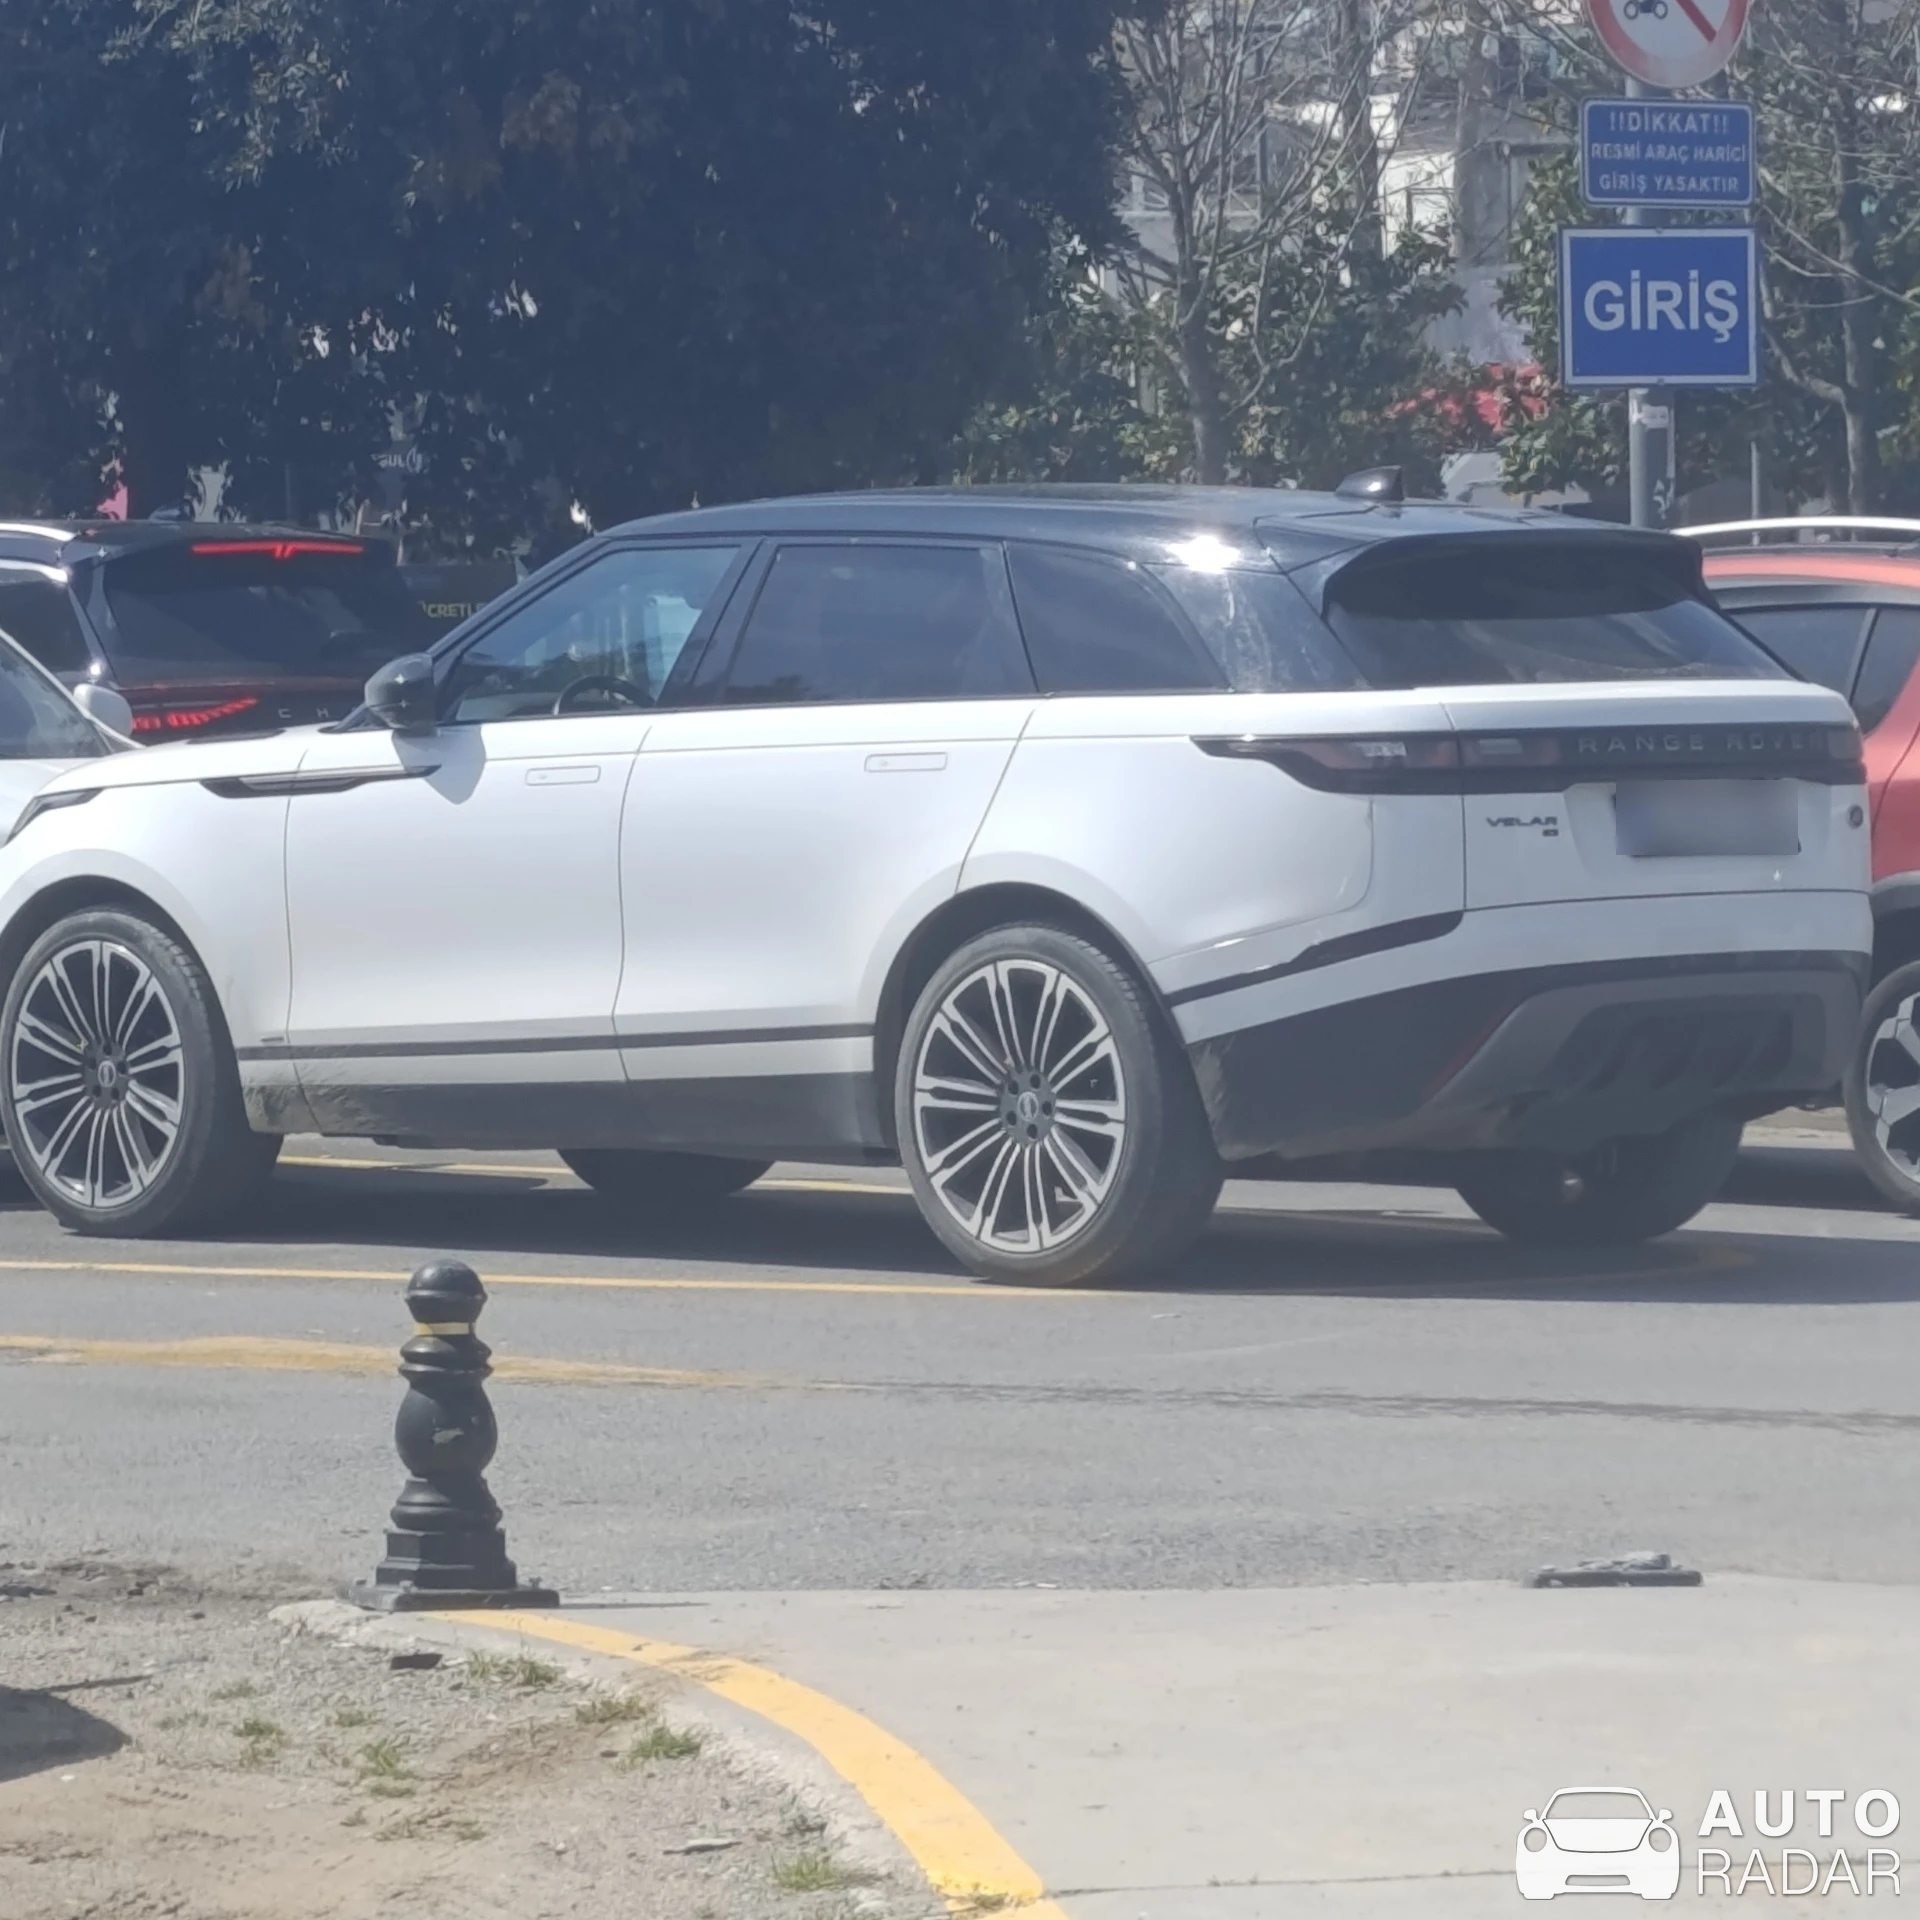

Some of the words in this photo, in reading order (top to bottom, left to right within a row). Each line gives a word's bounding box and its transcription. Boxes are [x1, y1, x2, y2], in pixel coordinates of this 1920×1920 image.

[1610, 108, 1728, 134] !!DİKKAT!!
[1591, 141, 1640, 161] RESMİ
[1645, 144, 1689, 165] ARAÇ
[1693, 144, 1746, 162] HARİCİ
[1599, 171, 1647, 194] GİRİŞ
[1654, 174, 1740, 192] YASAKTIR
[1584, 270, 1738, 342] GİRİŞ
[1578, 733, 1704, 753] RANGE
[1726, 732, 1827, 751] ROVER
[1485, 816, 1558, 827] VELAR
